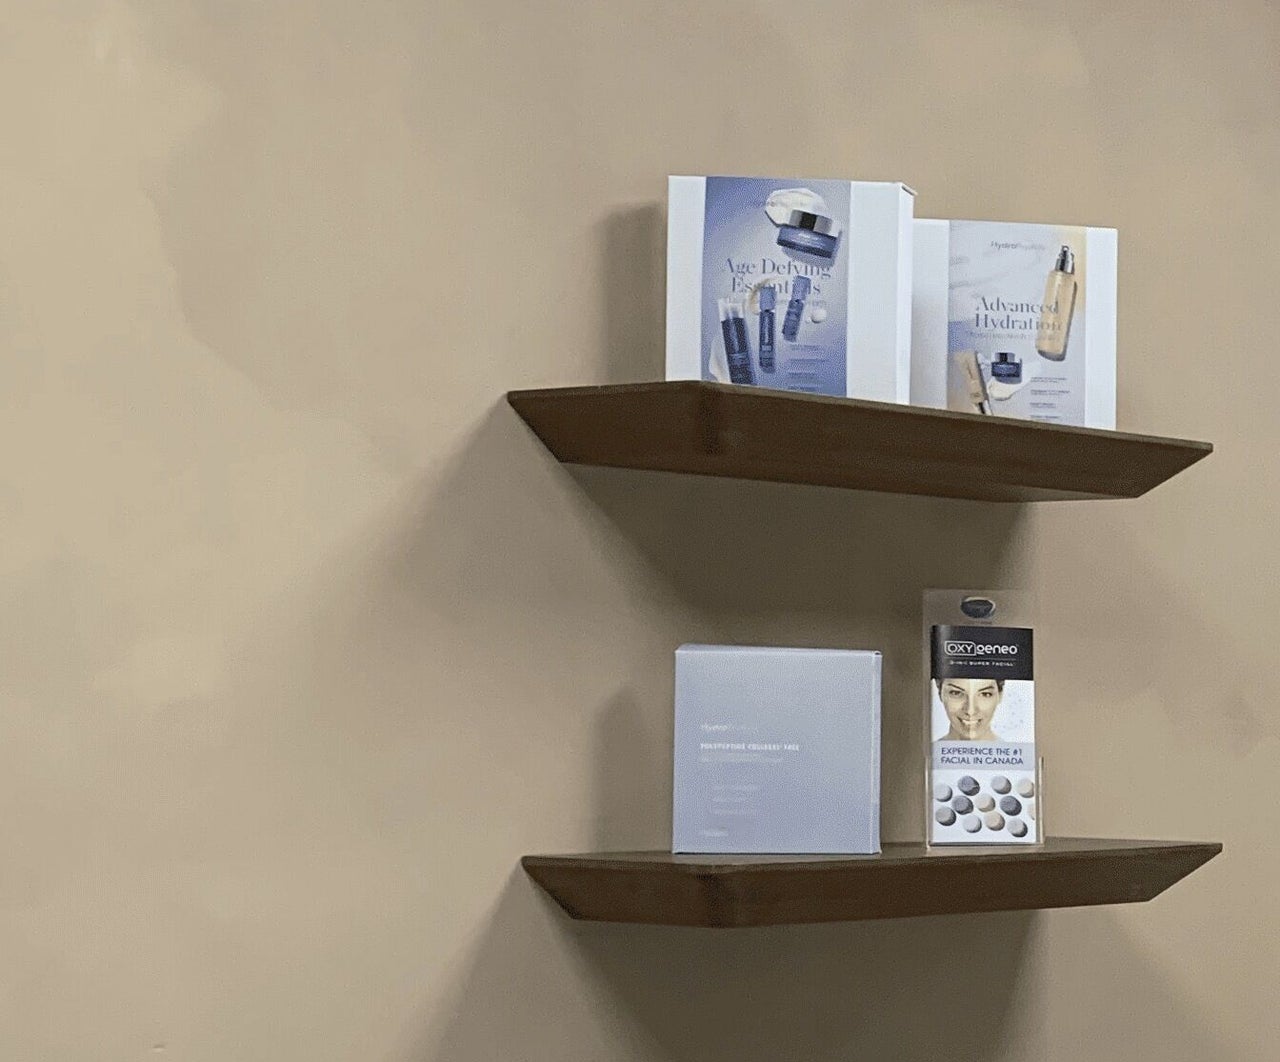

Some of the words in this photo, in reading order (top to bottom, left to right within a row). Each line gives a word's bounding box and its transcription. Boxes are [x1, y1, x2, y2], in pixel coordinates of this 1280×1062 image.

[723, 258, 756, 276] Age
[761, 258, 831, 279] Defying
[976, 296, 1058, 313] Advanced
[975, 313, 1063, 331] Hydration
[941, 747, 993, 756] EXPERIENCE
[996, 748, 1010, 757] THE
[1012, 748, 1023, 757] #1
[940, 756, 971, 765] FACIAL
[973, 757, 983, 765] IN
[984, 757, 1024, 766] CANADA
